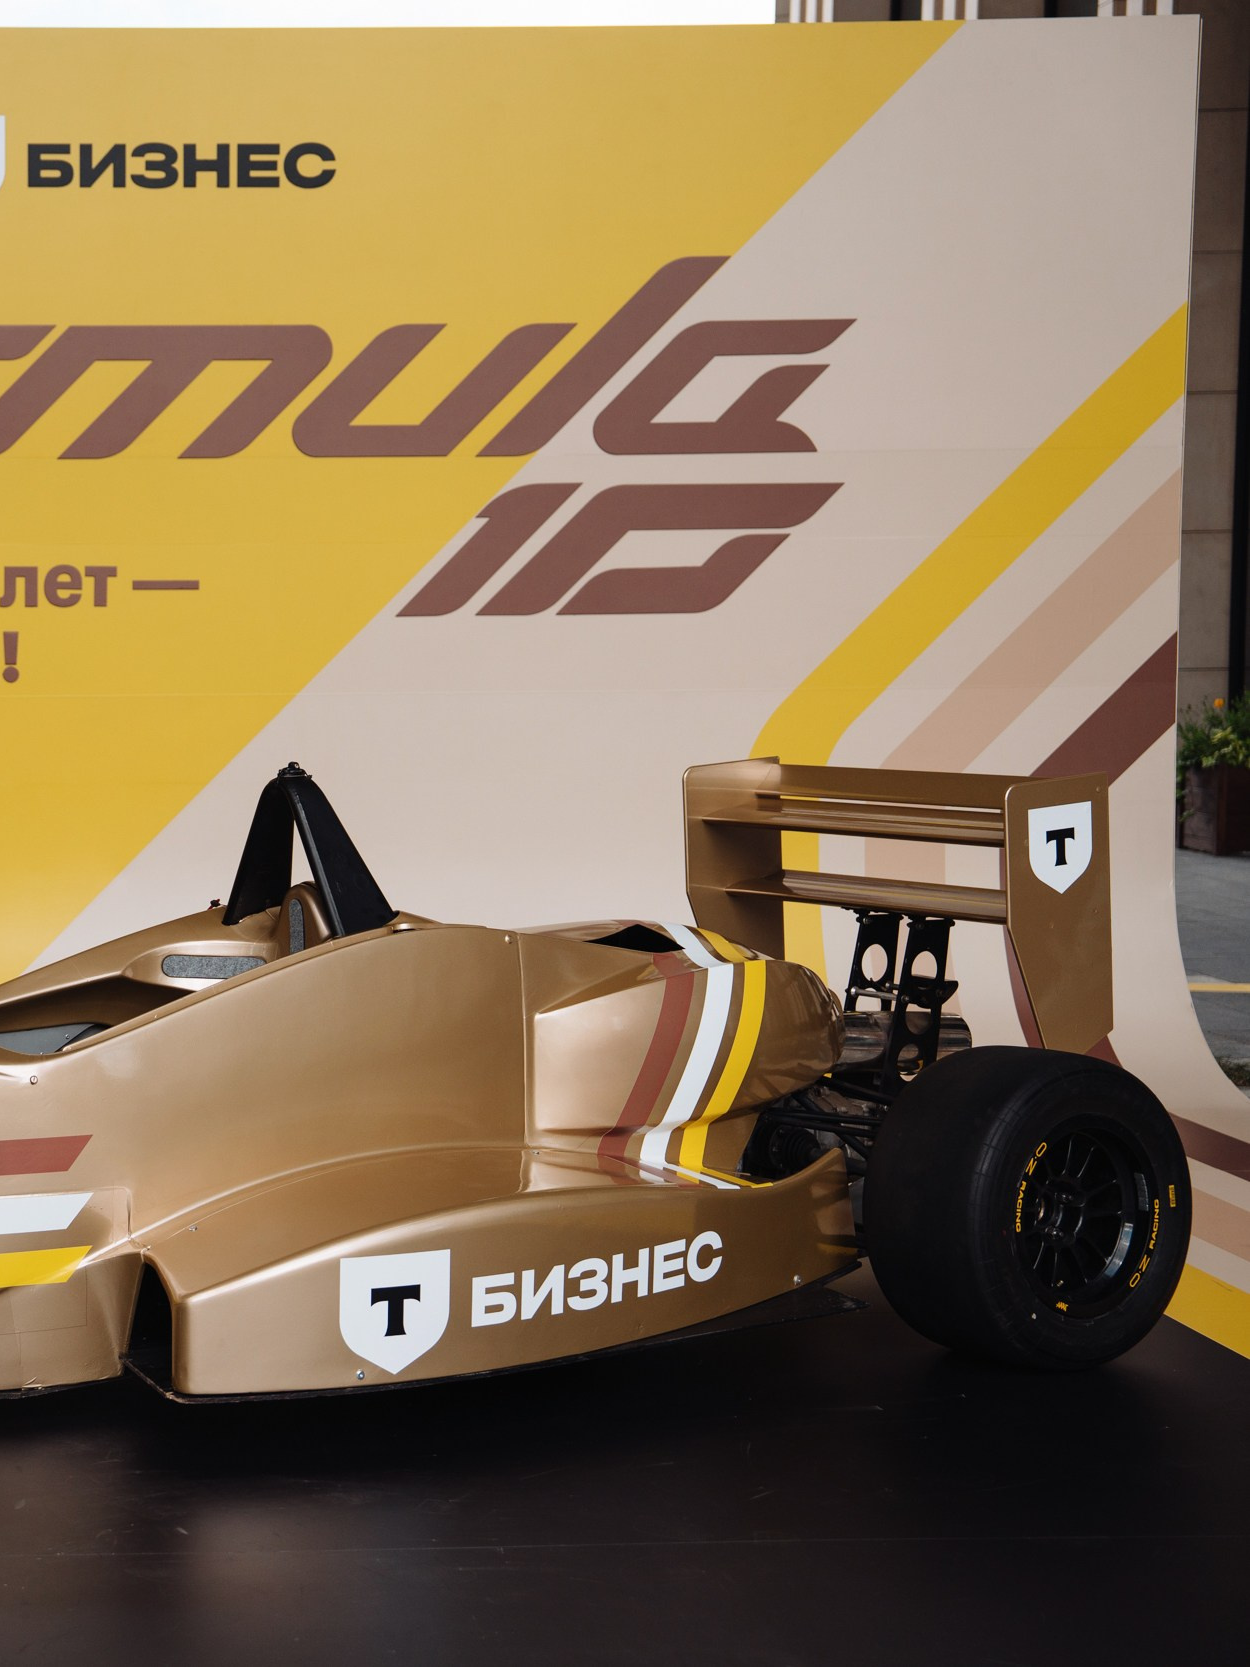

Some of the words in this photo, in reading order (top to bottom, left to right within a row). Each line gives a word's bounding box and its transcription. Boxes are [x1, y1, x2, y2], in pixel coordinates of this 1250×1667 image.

[27, 142, 337, 189] БИЗНЕС
[0, 564, 118, 608] лет
[1015, 1180, 1027, 1233] RACING
[1148, 1198, 1160, 1250] RACING
[471, 1230, 722, 1328] БИЗНЕС
